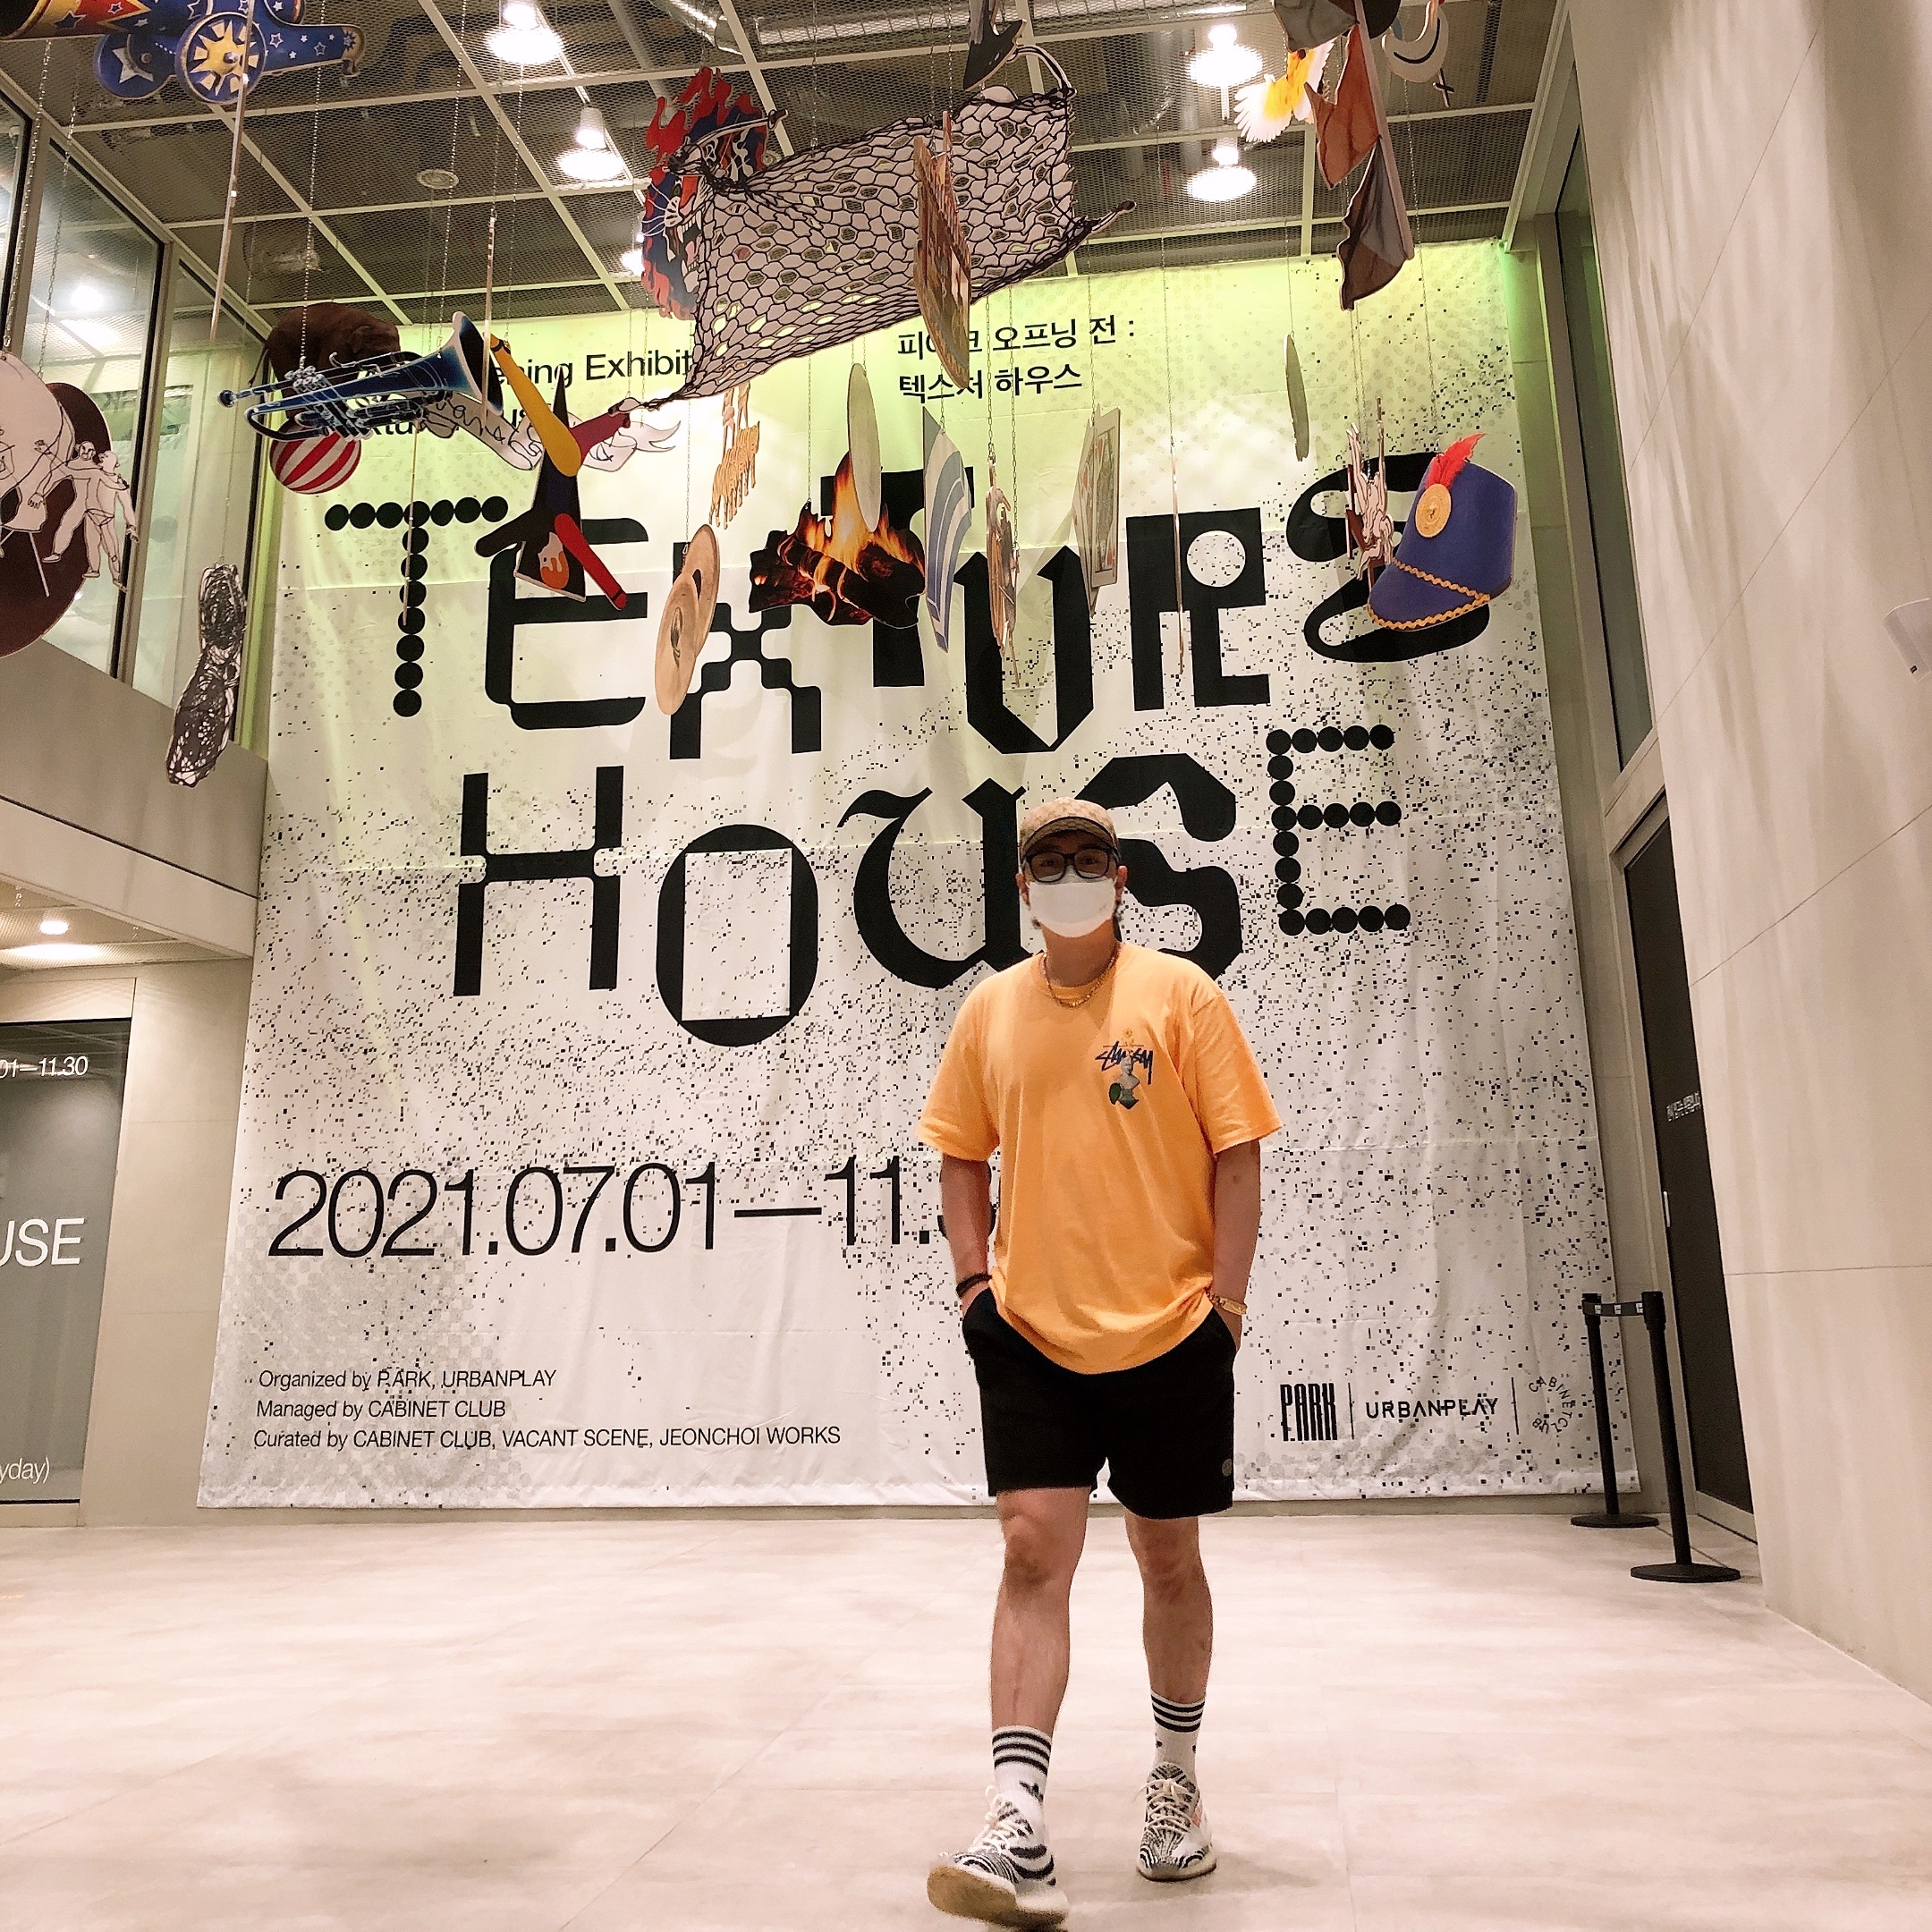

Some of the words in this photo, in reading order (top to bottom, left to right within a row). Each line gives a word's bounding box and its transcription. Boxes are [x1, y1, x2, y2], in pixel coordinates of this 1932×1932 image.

[993, 318, 1077, 352] 오프닝
[586, 349, 691, 380] Exhibit
[994, 363, 1083, 396] 하우스
[453, 723, 1411, 1046] HOUSE
[258, 1370, 346, 1391] Organized
[352, 1370, 372, 1391] by
[442, 1369, 557, 1387] URBANPLAY
[257, 1401, 338, 1421] Managed
[343, 1401, 363, 1420] by
[368, 1400, 450, 1418] CABINET
[454, 1399, 506, 1417] CLUB
[1365, 1397, 1498, 1419] URBANPLAY
[254, 1430, 322, 1448] Curated
[326, 1430, 349, 1452] by
[353, 1430, 436, 1448] CABINET
[439, 1430, 496, 1450] CLUB,
[503, 1429, 579, 1447] VACANT
[583, 1428, 653, 1449] SCENE,
[659, 1428, 760, 1446] JEONCHOI
[767, 1426, 842, 1445] WORKS
